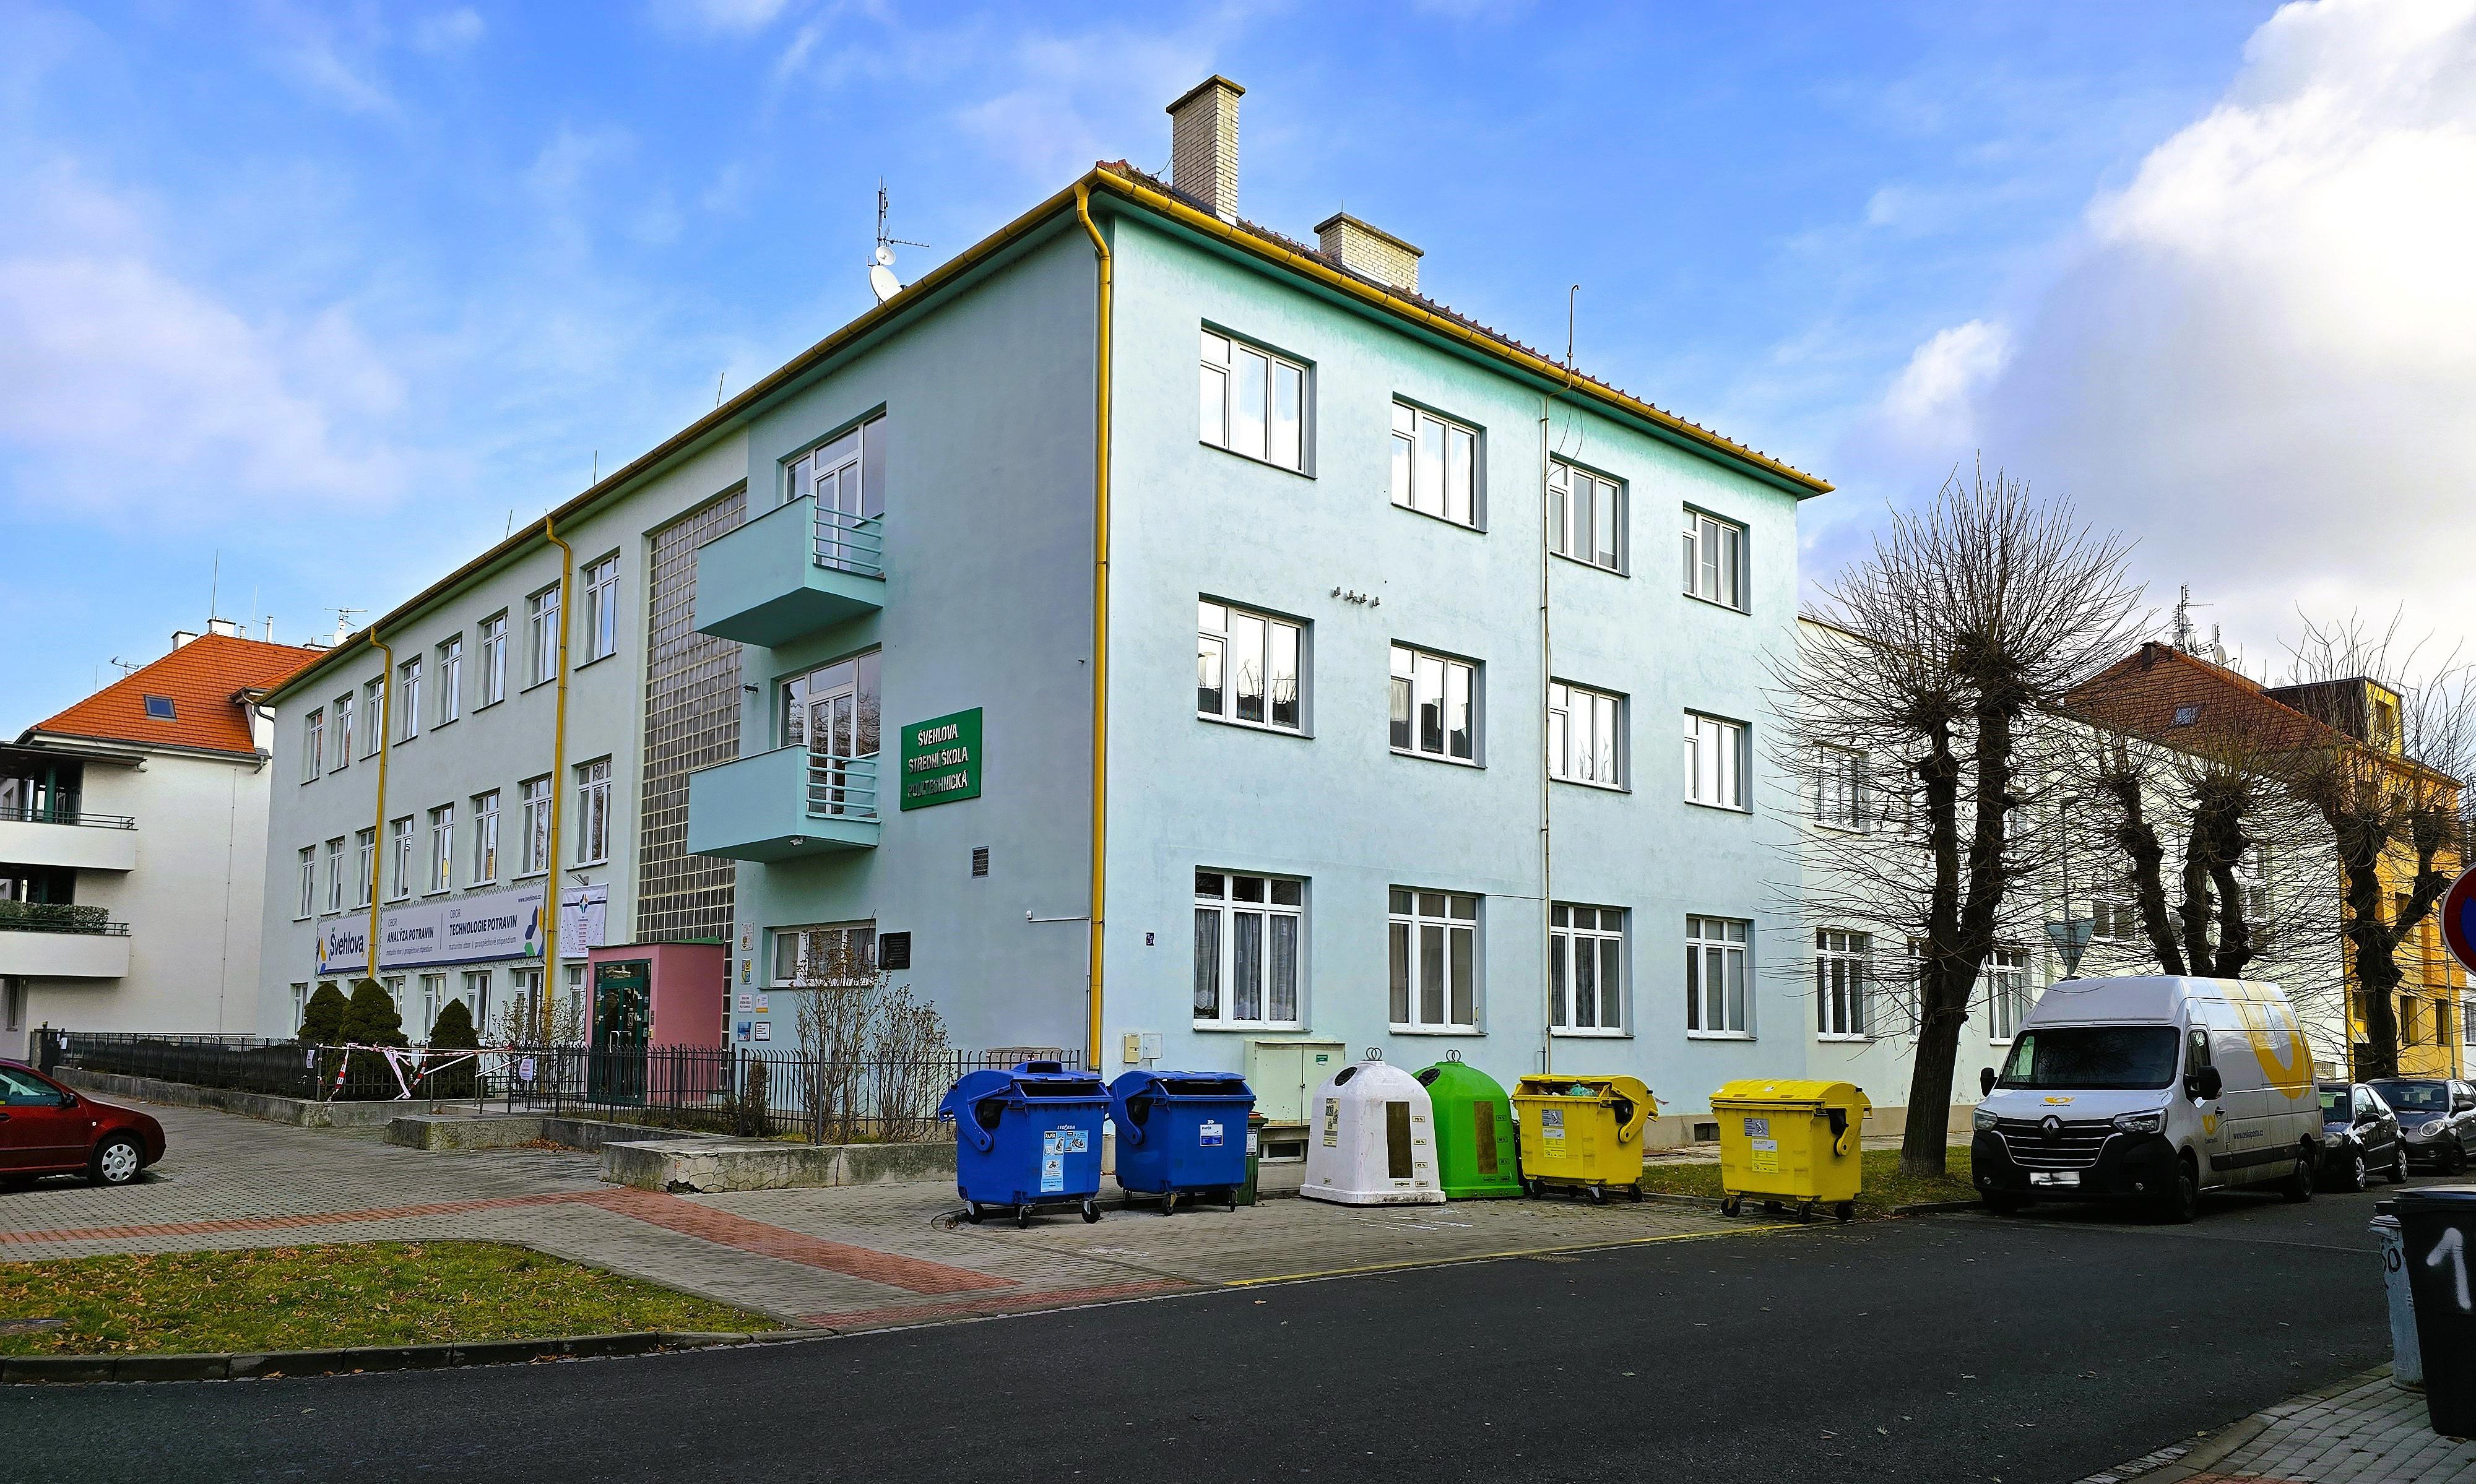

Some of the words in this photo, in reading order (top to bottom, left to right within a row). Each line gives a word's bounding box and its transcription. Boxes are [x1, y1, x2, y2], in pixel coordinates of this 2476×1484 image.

[917, 723, 959, 746] ŠVEHLOVA
[908, 750, 941, 774] STŘEDNÍ
[941, 746, 969, 766] ŠKOLA
[449, 908, 461, 918] OBOR
[387, 928, 409, 943] ANALÝZA
[409, 926, 435, 941] POTRAVIN
[449, 919, 487, 936] TECHNOLOGIE
[487, 914, 517, 931] POTRAVIN
[330, 926, 364, 957] Švehlova
[2426, 1227, 2472, 1311] 1
